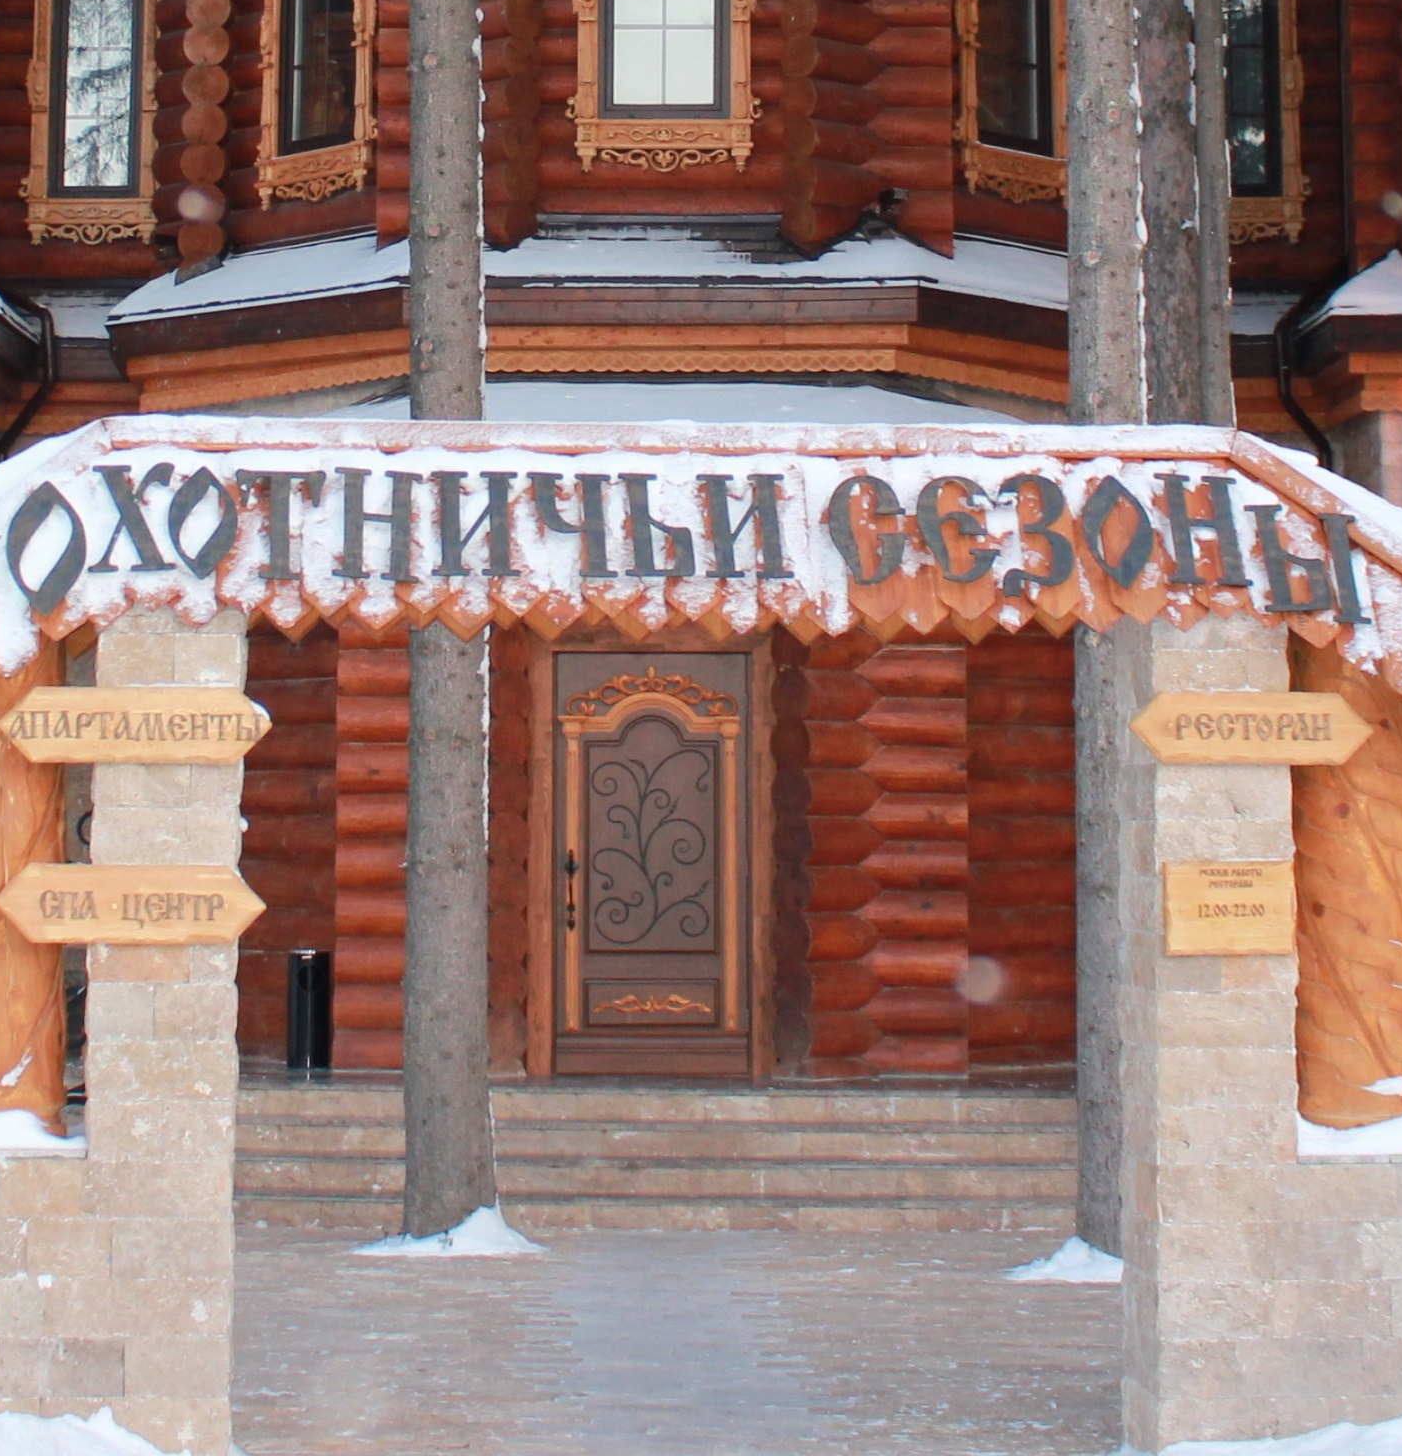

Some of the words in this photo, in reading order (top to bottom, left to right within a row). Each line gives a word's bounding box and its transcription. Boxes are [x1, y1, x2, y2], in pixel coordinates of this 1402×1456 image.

[6, 461, 796, 616] ОХОТНИЧЬИ
[827, 473, 1373, 625] СЕЗОНЫ
[9, 709, 264, 742] АПАРТАМЕНТЫ
[1175, 712, 1333, 742] РЕСТОРАН
[39, 889, 99, 920] СПА
[121, 892, 225, 929] ЦЕНТР
[1198, 903, 1266, 918] 12.00-22.00
